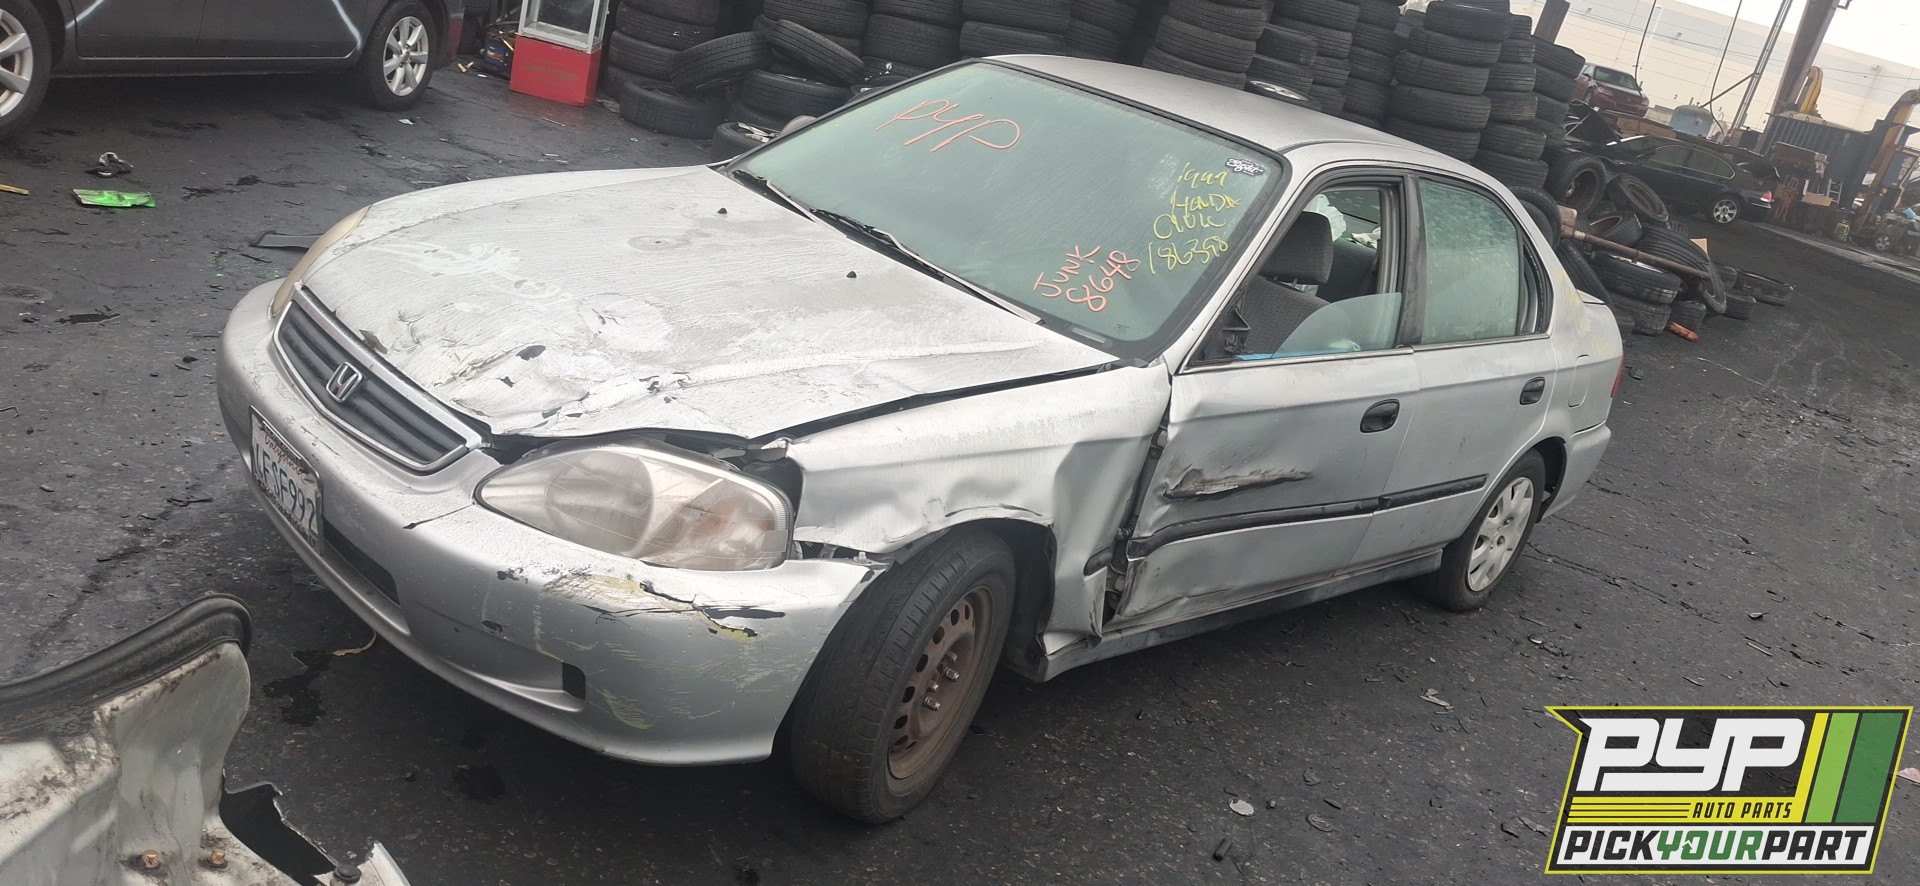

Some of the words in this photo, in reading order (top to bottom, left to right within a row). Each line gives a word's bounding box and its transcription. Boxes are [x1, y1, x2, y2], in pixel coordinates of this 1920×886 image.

[875, 99, 1021, 152] PYP
[1033, 245, 1101, 298] JUNK
[1066, 250, 1141, 312] 8648
